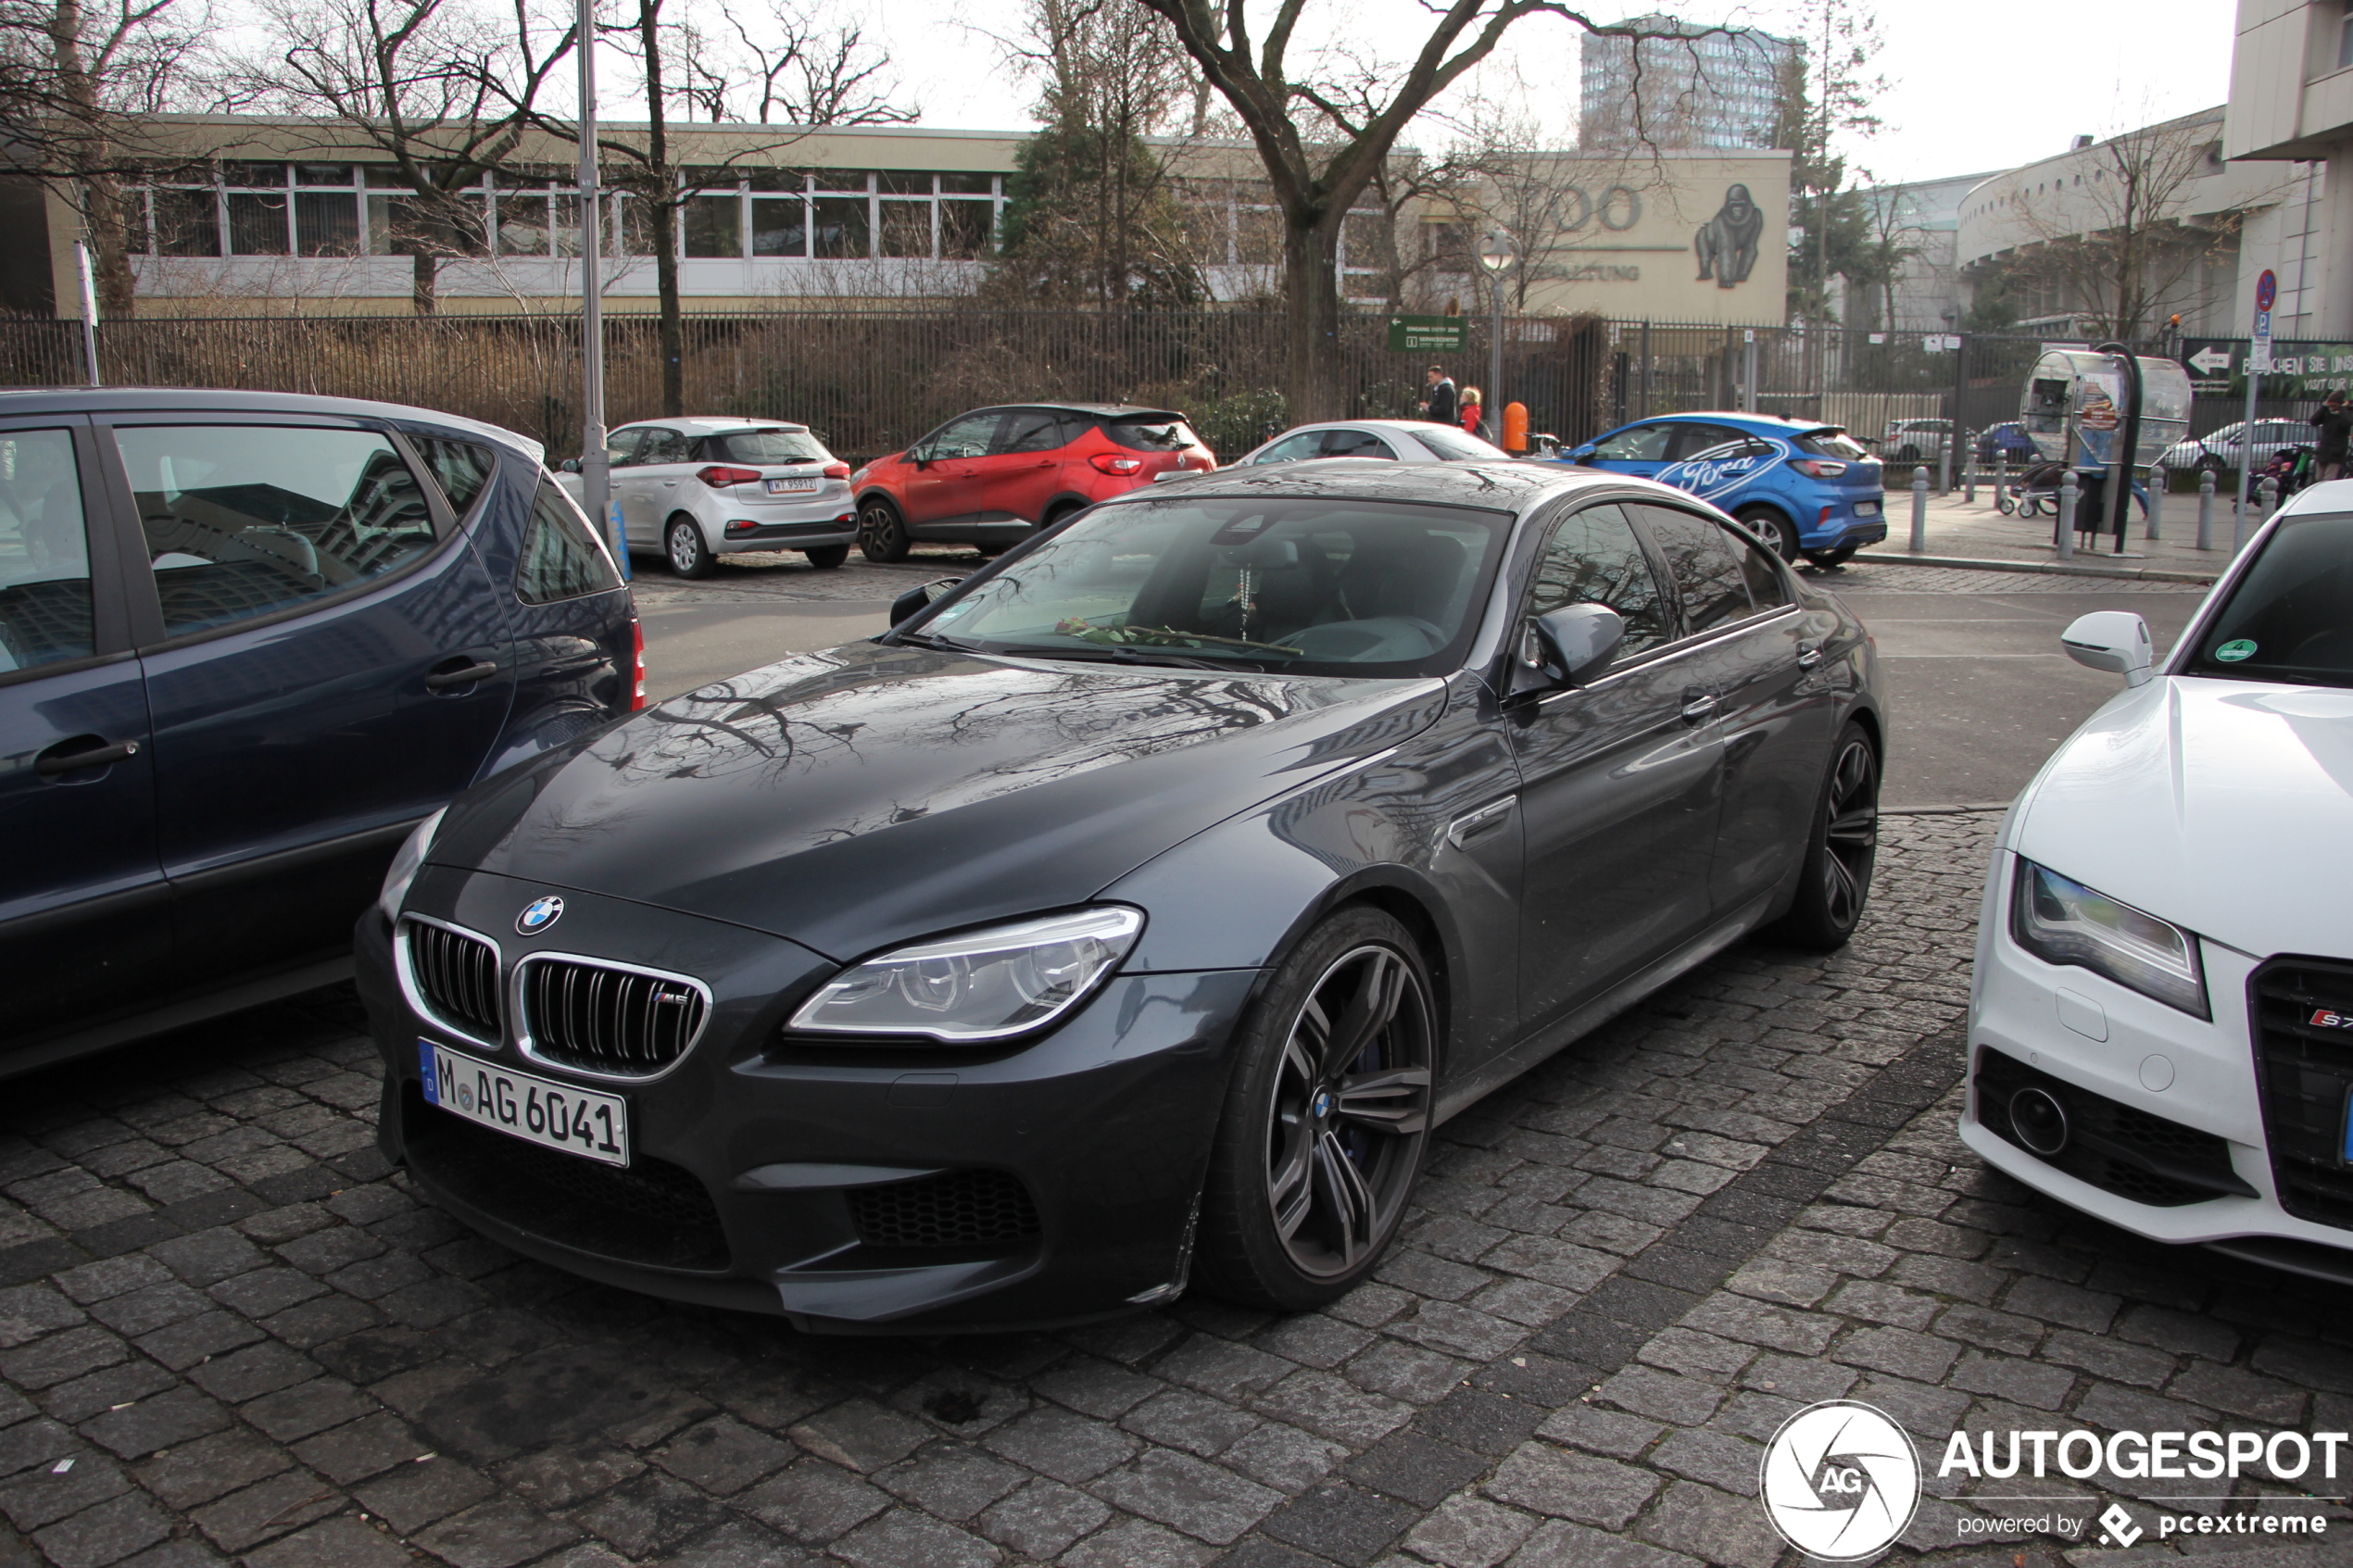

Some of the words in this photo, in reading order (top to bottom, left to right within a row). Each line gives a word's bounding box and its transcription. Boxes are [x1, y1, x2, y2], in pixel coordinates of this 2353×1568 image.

[2242, 357, 2303, 376] BCHEN
[2309, 356, 2326, 373] SIE
[2304, 379, 2327, 391] VISIT
[2328, 378, 2347, 391] OUR
[774, 481, 785, 490] WT
[788, 479, 813, 489] 95912
[2233, 641, 2245, 650] 4
[663, 993, 688, 1005] M6
[2321, 1014, 2353, 1028] S7
[427, 1078, 434, 1092] D
[437, 1053, 456, 1104] M
[477, 1070, 518, 1126] AG
[526, 1085, 622, 1155] 6041
